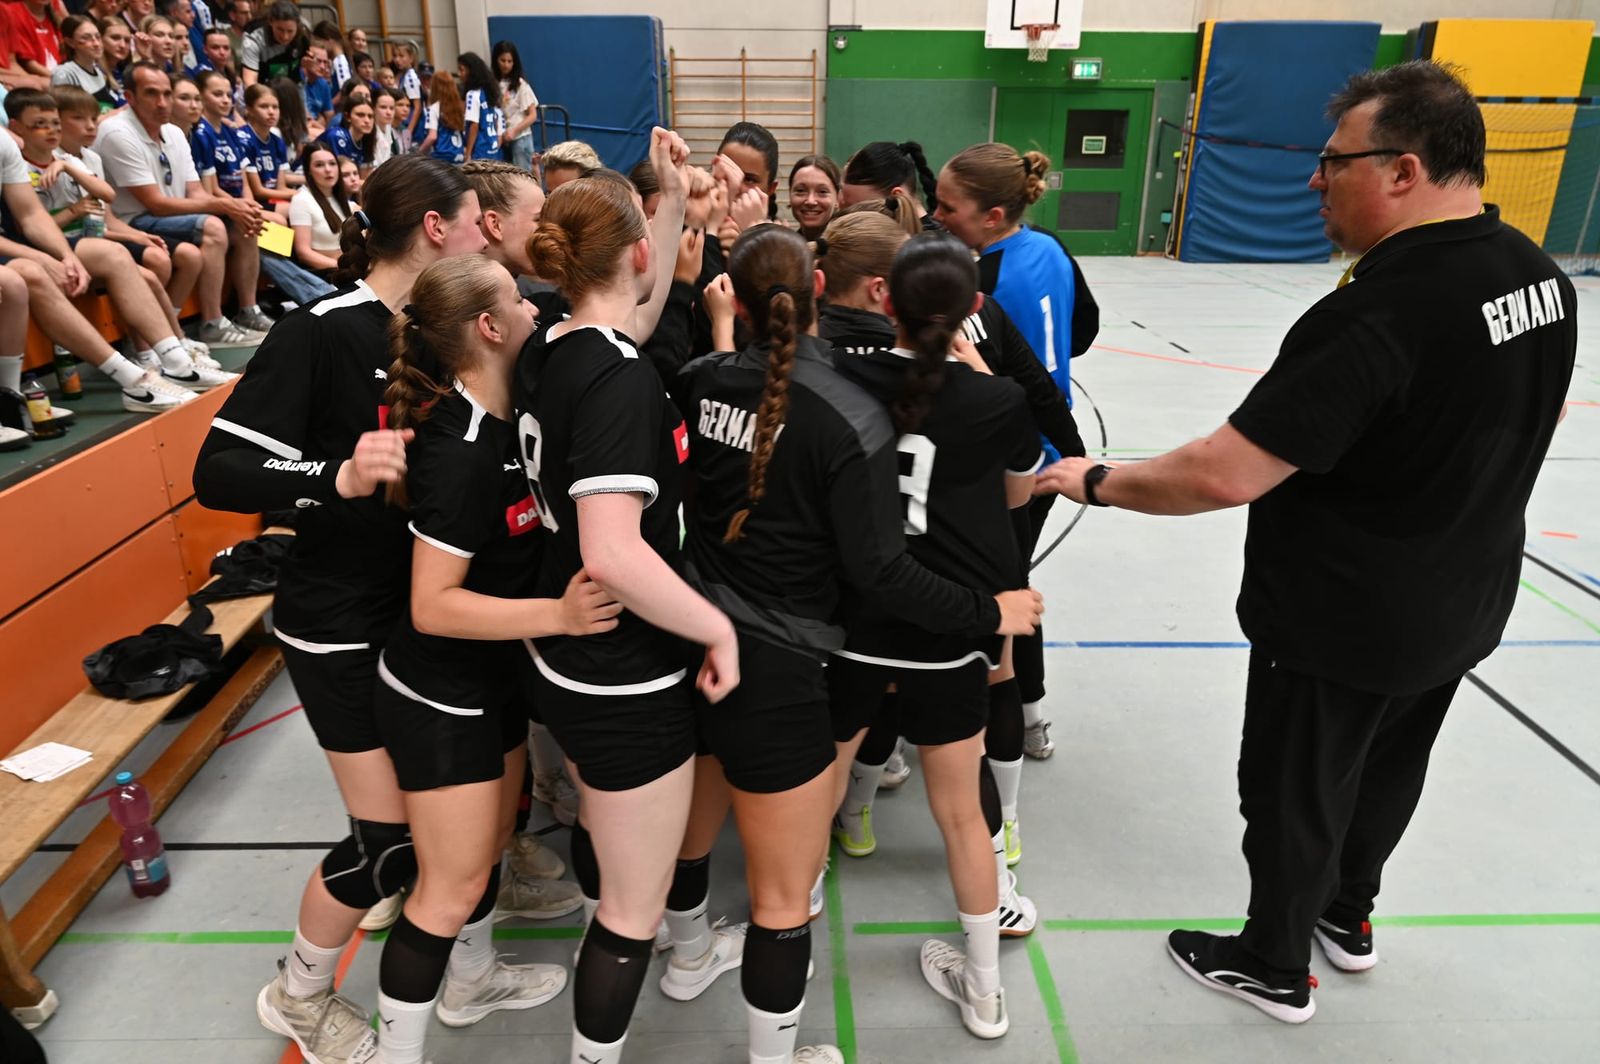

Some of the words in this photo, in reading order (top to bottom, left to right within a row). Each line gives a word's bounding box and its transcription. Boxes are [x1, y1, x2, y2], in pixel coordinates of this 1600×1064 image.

[1481, 277, 1565, 346] GERMANY
[698, 398, 785, 454] GERMA
[262, 457, 327, 476] Kempa
